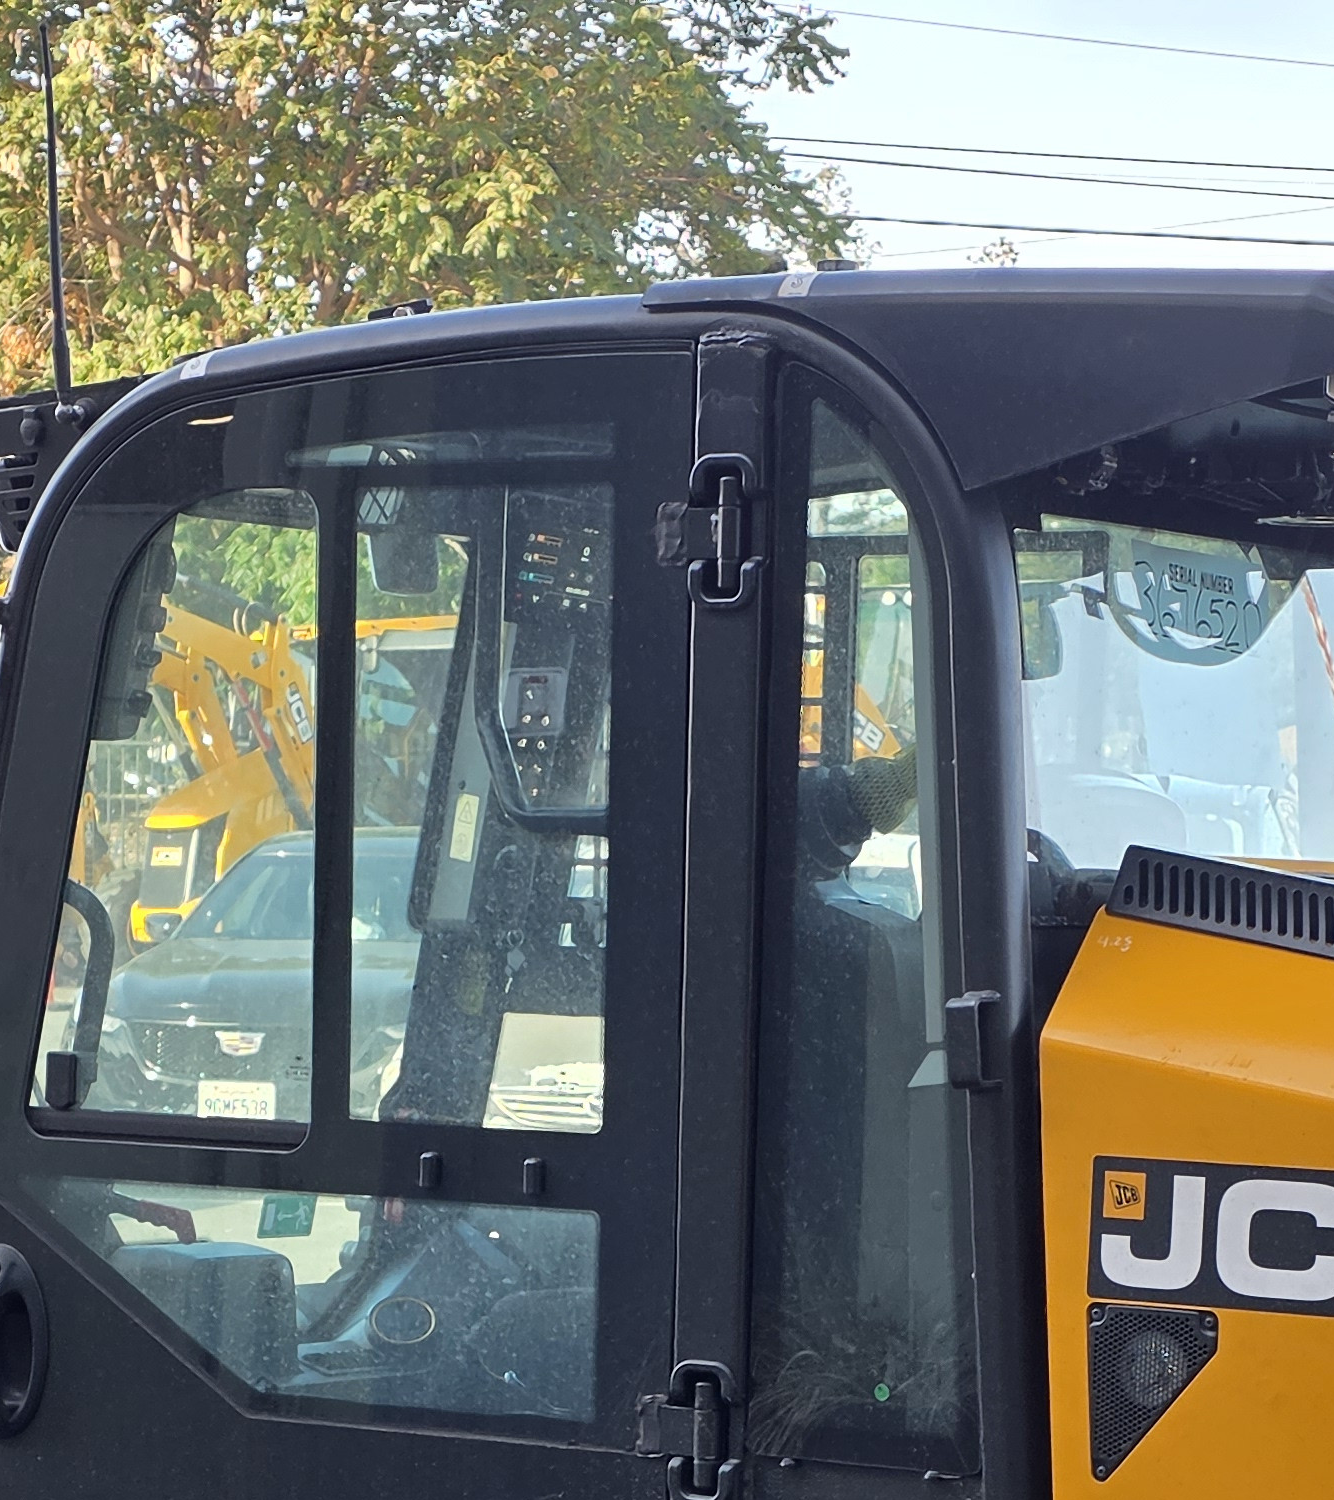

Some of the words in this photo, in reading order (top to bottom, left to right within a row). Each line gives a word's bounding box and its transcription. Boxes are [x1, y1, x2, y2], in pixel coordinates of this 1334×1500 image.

[1169, 563, 1197, 587] SERIAL
[1200, 571, 1234, 596] NUMBER
[286, 688, 313, 743] JCB
[1115, 1184, 1138, 1206] JCB
